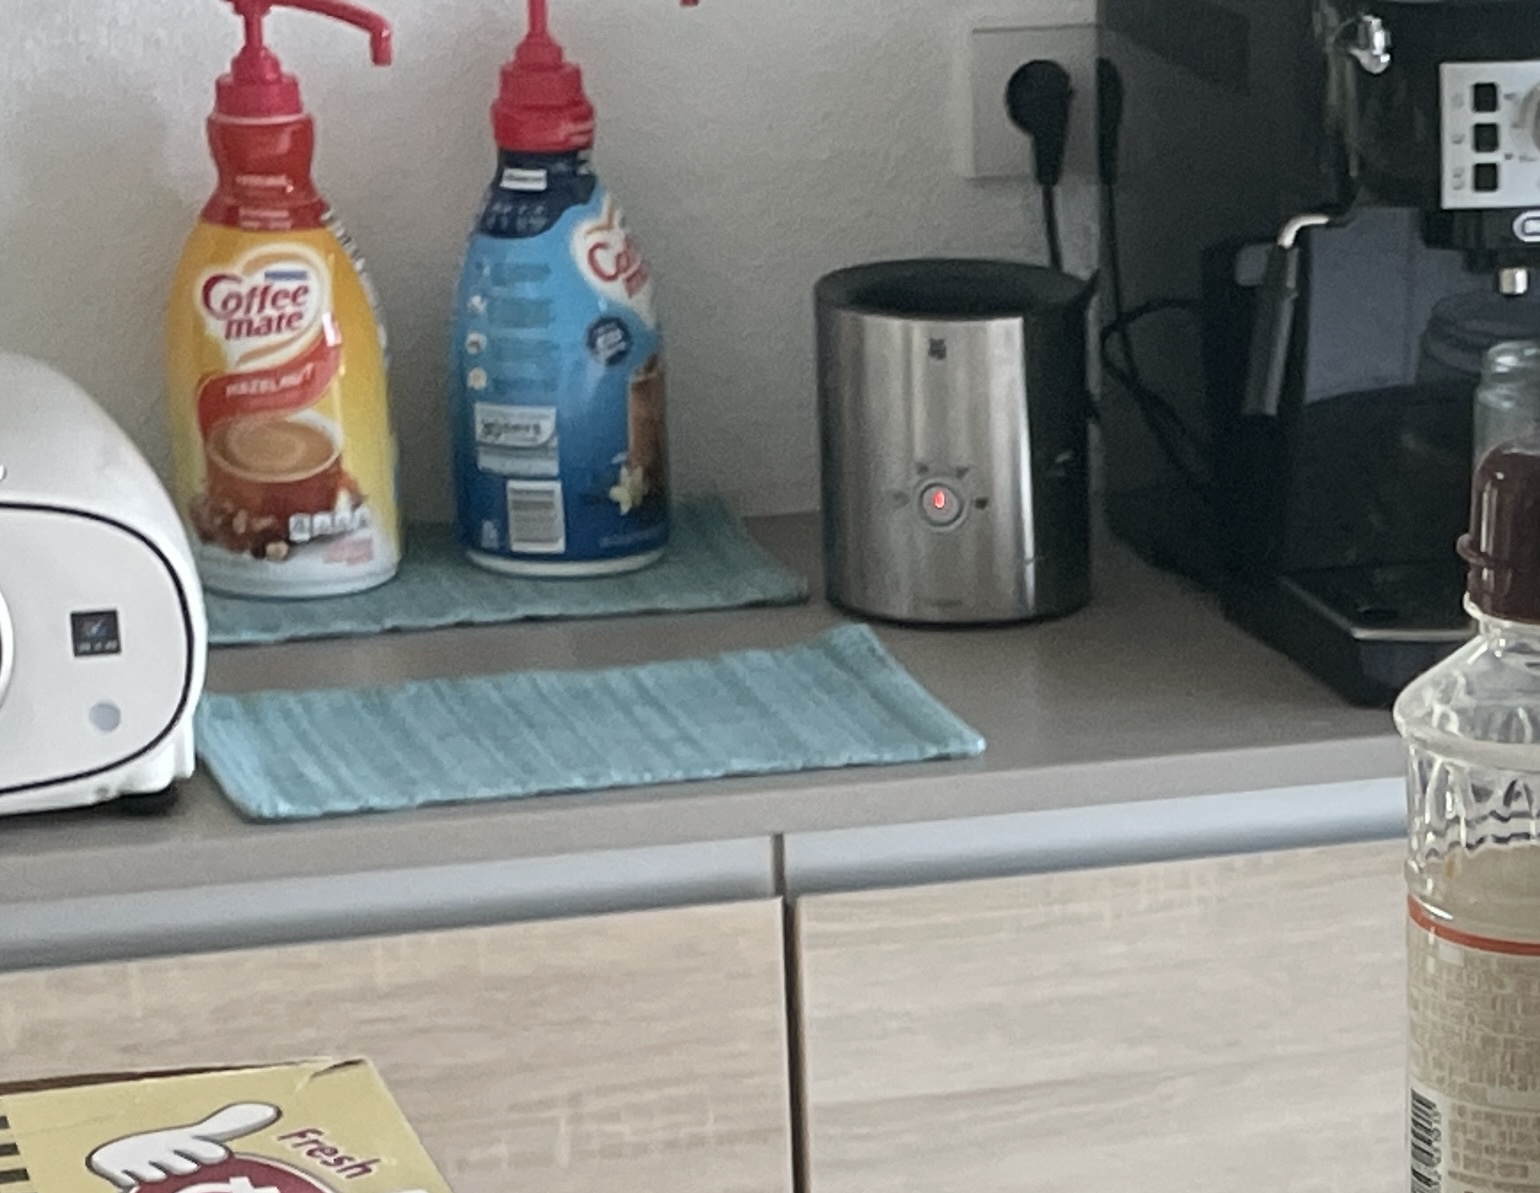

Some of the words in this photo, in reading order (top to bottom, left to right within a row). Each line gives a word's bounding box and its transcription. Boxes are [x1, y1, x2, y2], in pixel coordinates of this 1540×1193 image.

[202, 273, 309, 320] Coffee
[224, 311, 304, 340] mate
[278, 1127, 381, 1180] Fresh
